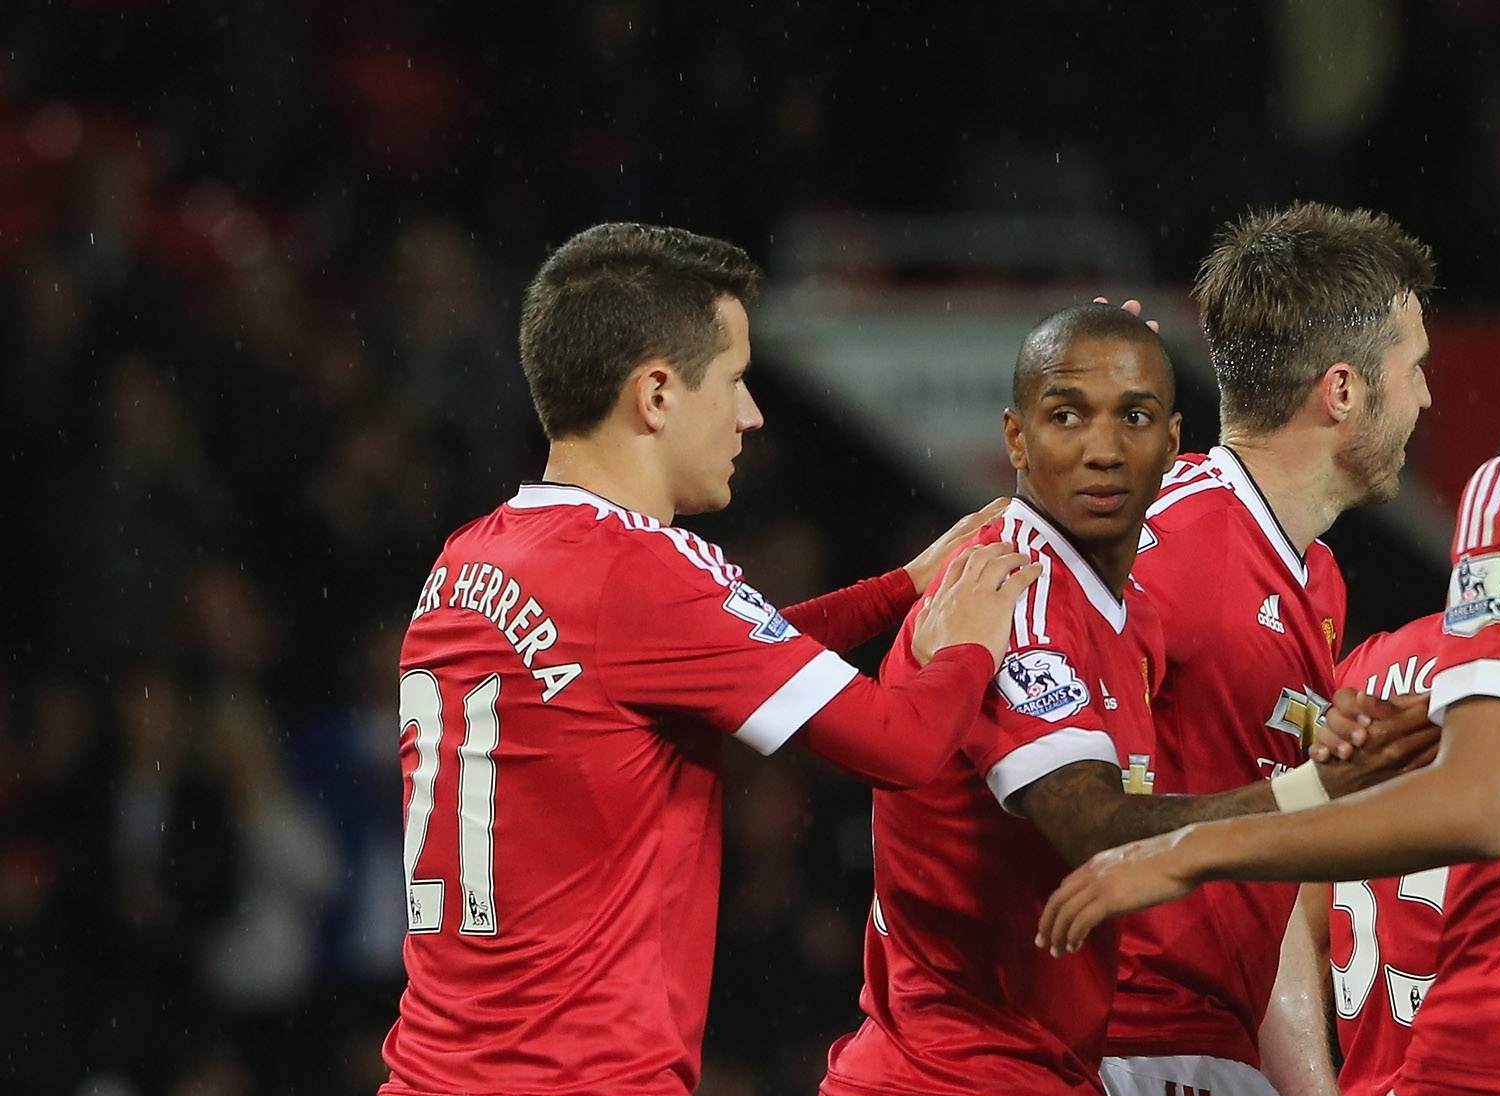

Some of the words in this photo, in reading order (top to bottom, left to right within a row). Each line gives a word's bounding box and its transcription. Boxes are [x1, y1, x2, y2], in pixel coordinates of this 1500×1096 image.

[412, 566, 448, 622] ER
[448, 561, 584, 704] HERRERA
[1257, 613, 1286, 634] adidas
[398, 668, 501, 935] 21
